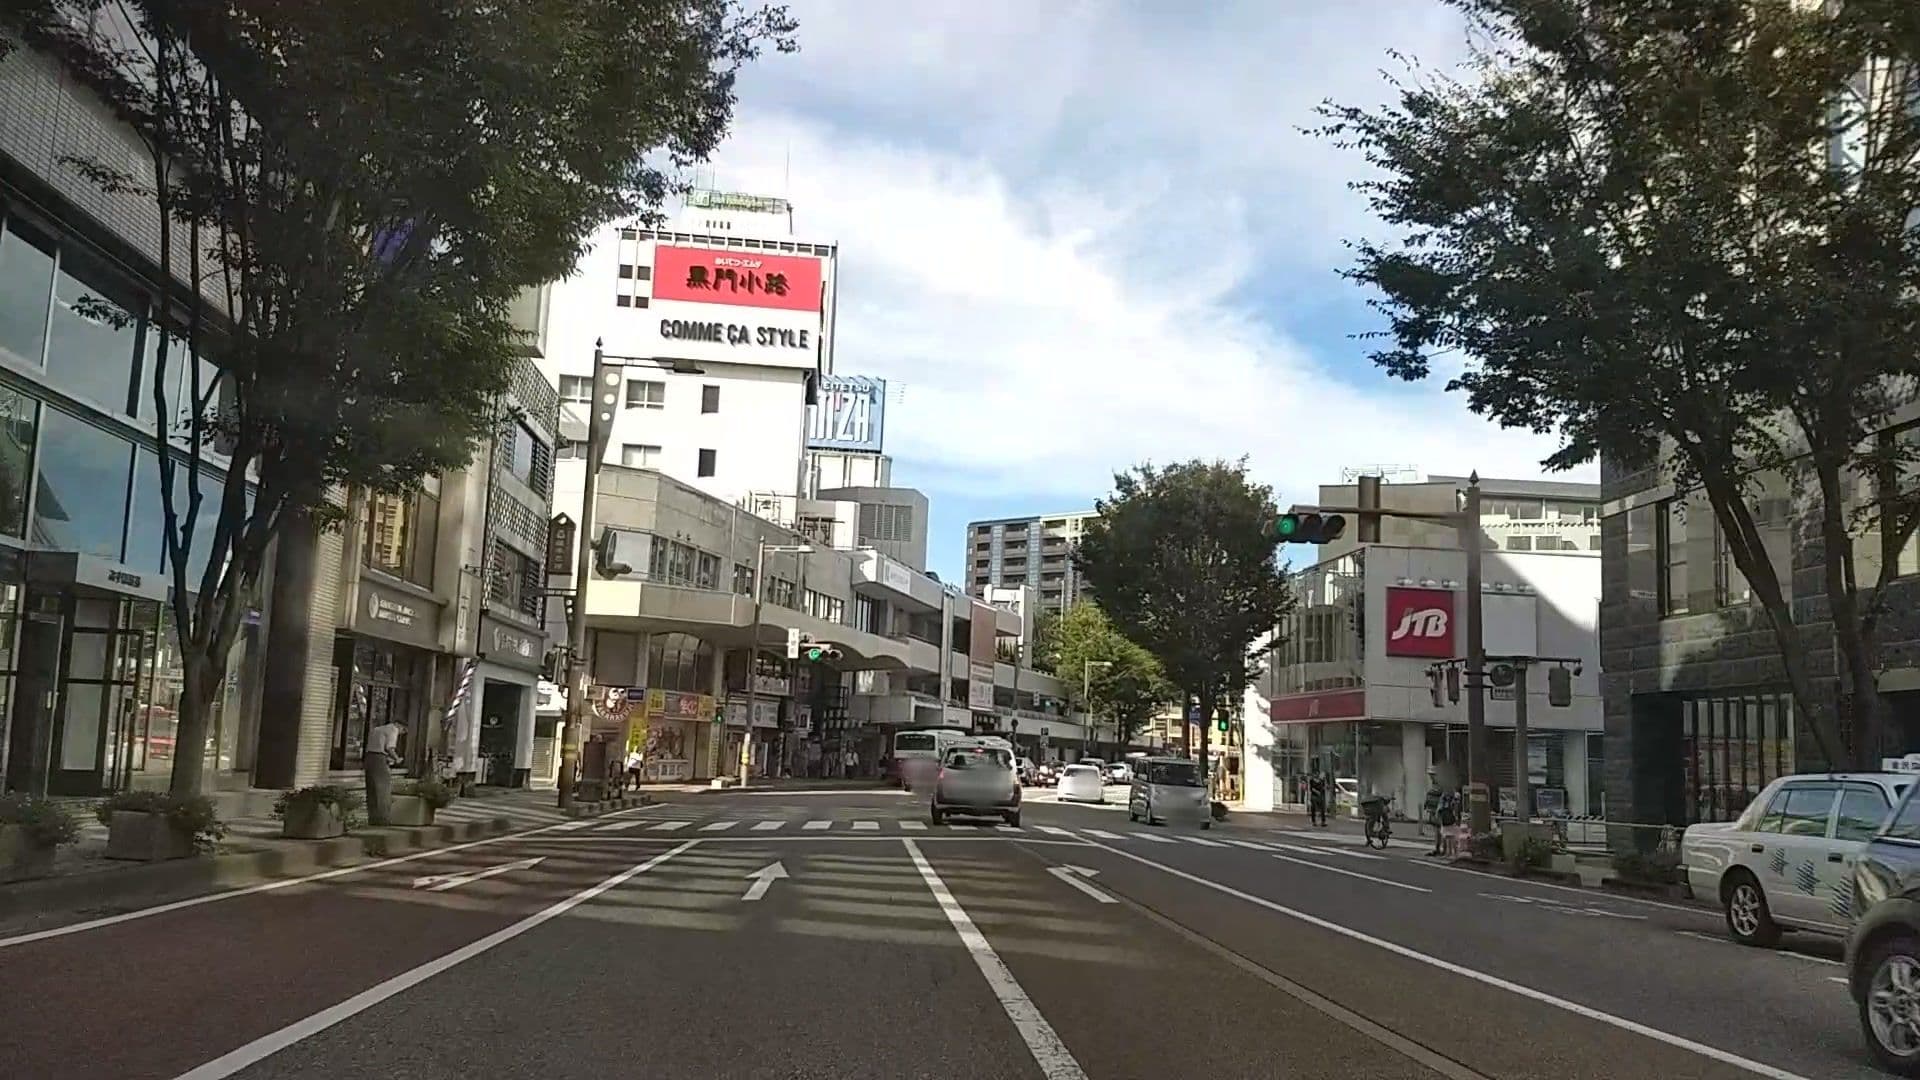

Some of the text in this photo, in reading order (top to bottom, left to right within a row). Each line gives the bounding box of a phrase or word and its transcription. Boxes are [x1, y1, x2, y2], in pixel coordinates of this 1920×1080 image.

[686, 265, 791, 296] 黒門小路
[660, 318, 723, 343] COMME
[757, 326, 809, 349] STYLE
[1391, 608, 1449, 640] JTB
